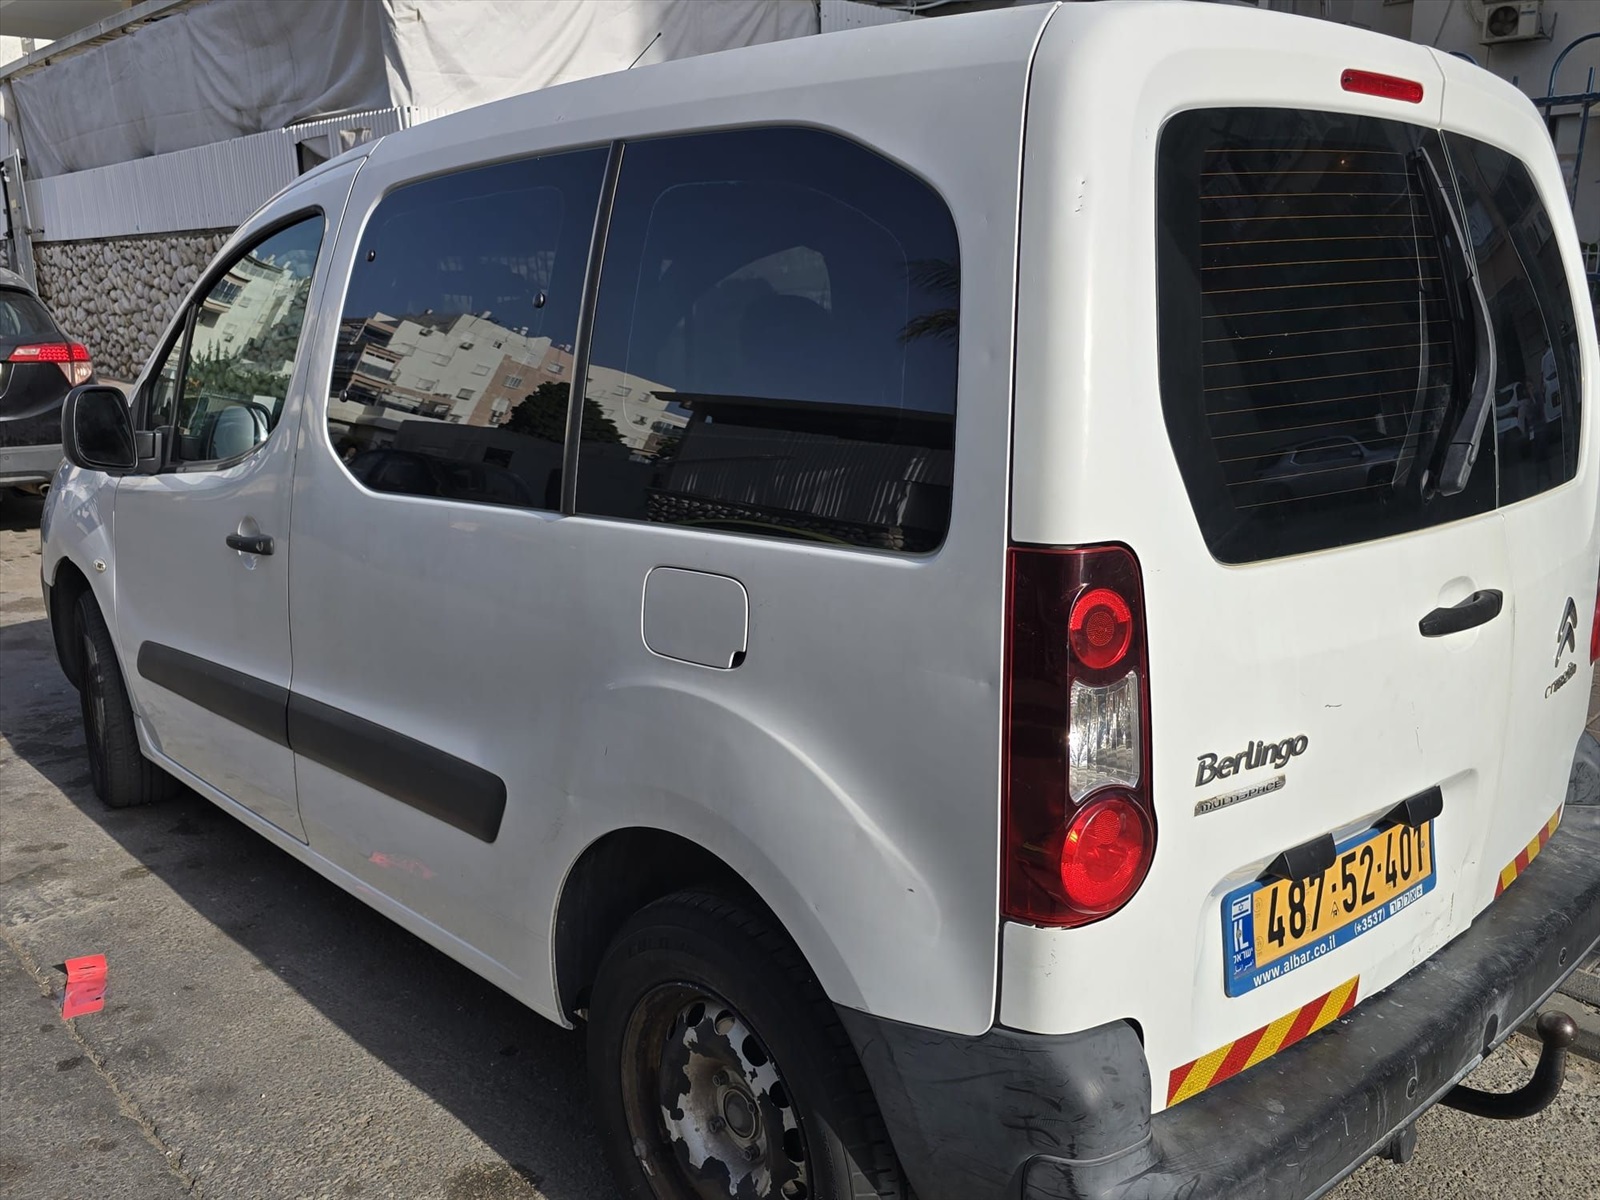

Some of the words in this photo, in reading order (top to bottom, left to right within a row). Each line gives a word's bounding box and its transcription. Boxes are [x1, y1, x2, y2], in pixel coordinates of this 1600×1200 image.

[1195, 734, 1309, 788] Berlingo
[1233, 919, 1249, 952] IL
[1253, 935, 1336, 987] www.albar.co.il
